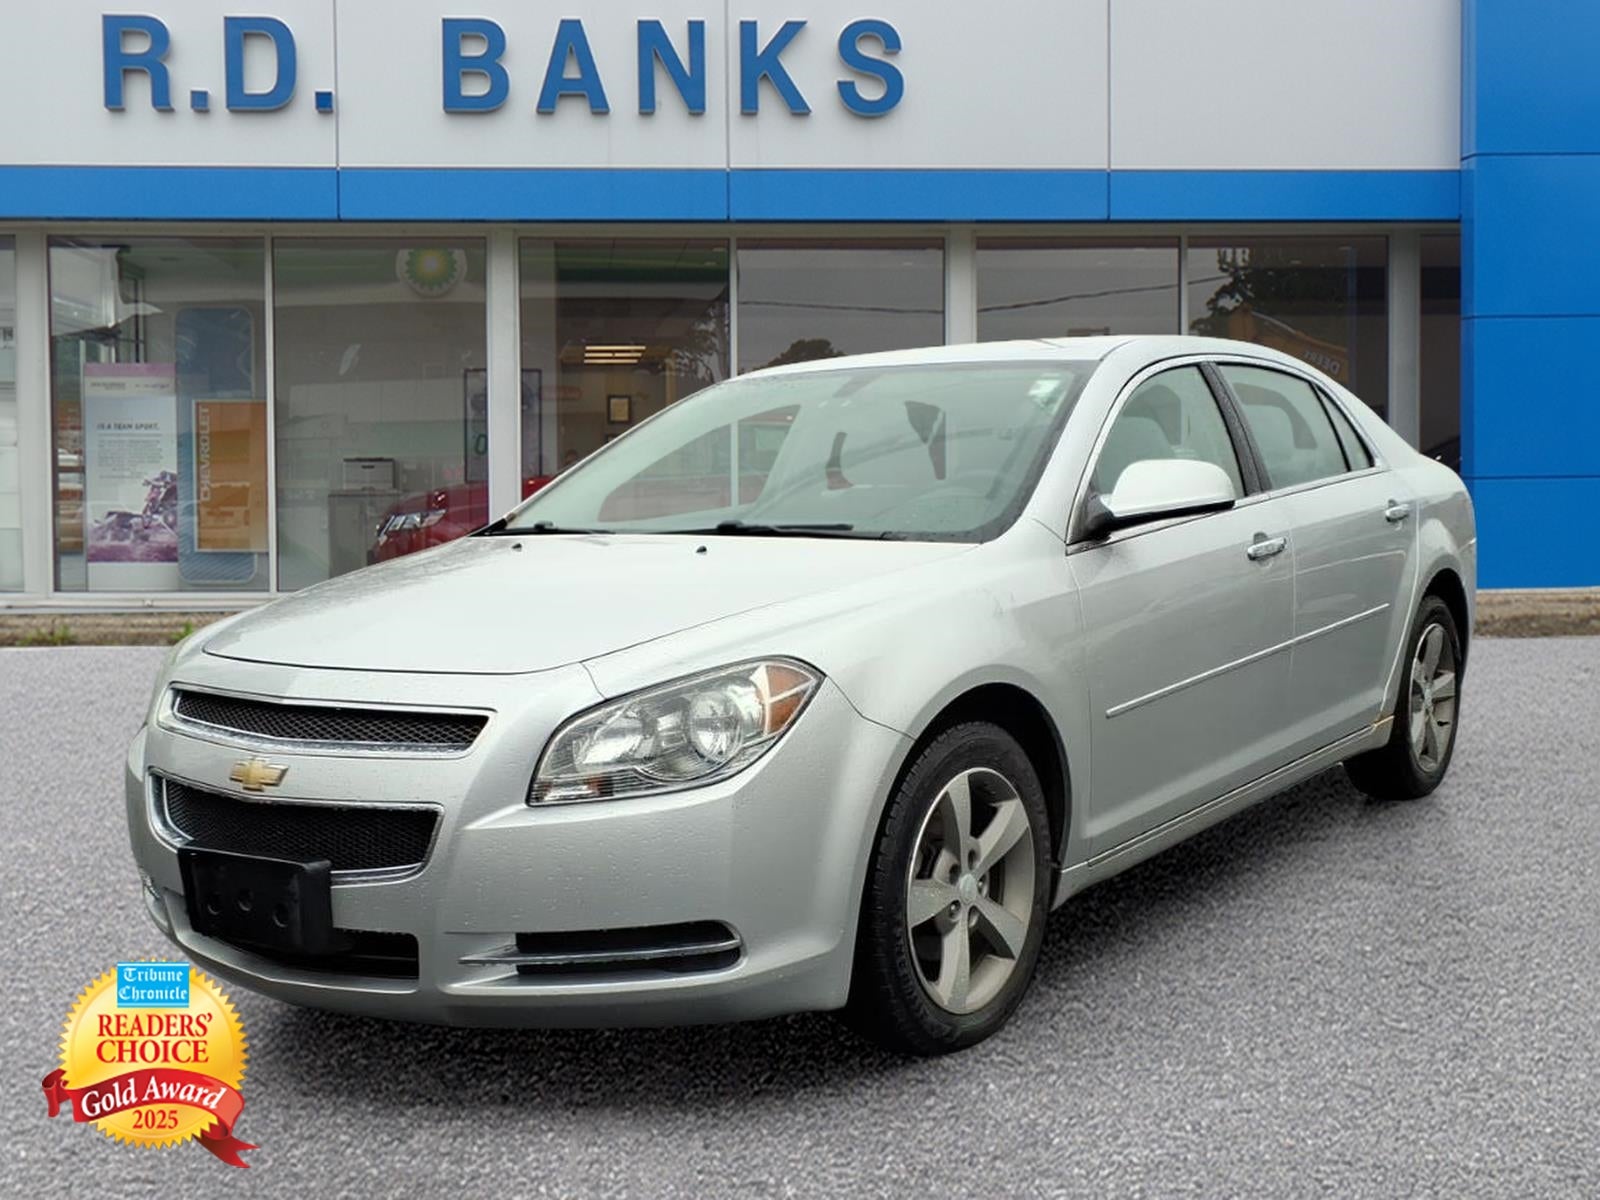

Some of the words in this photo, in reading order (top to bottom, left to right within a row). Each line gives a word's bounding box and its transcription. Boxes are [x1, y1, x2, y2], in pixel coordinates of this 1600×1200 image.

[102, 13, 334, 112] R.D.
[442, 17, 905, 117] BANKS
[200, 406, 210, 500] CHEVROLET
